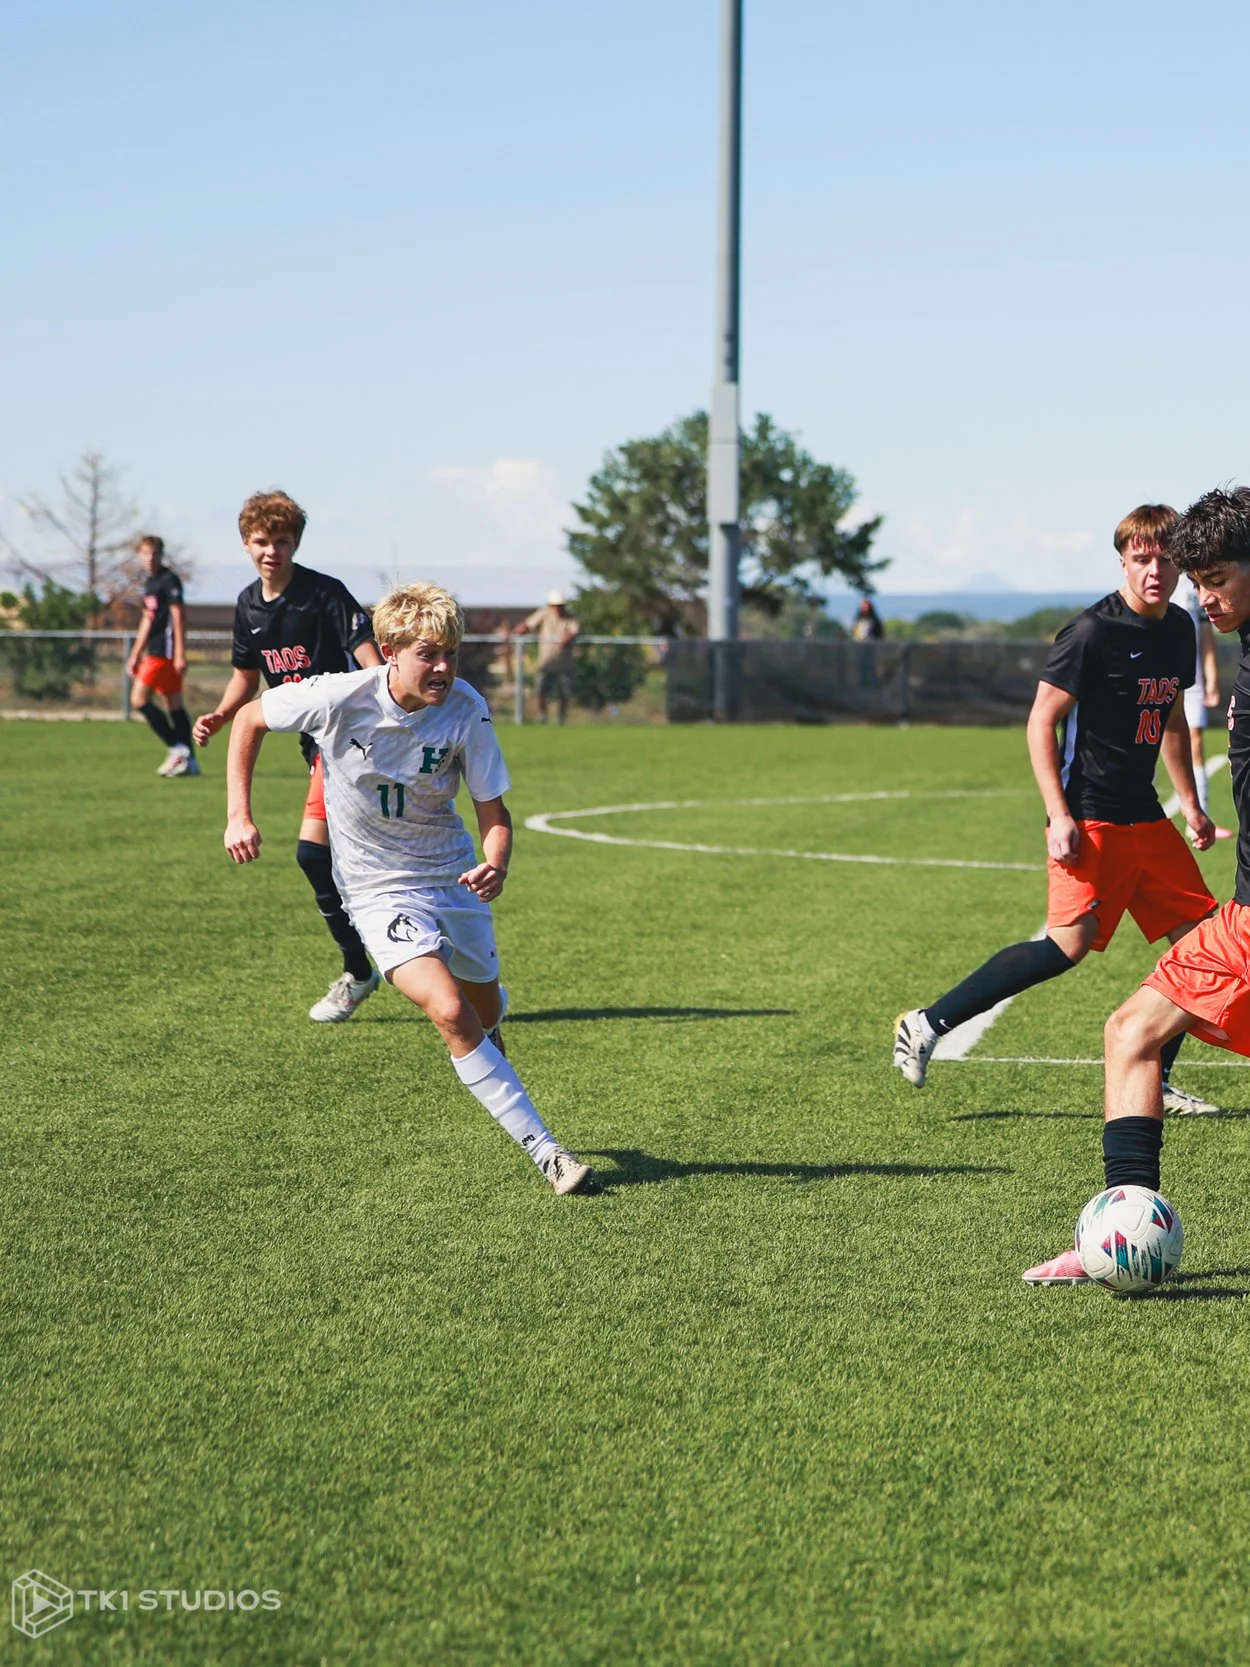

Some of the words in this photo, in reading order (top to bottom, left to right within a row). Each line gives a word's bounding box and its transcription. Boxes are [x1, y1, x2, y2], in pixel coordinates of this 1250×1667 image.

[261, 645, 311, 674] TAOS
[1137, 677, 1179, 704] TAOS
[1135, 709, 1161, 744] 10
[376, 783, 405, 818] 11
